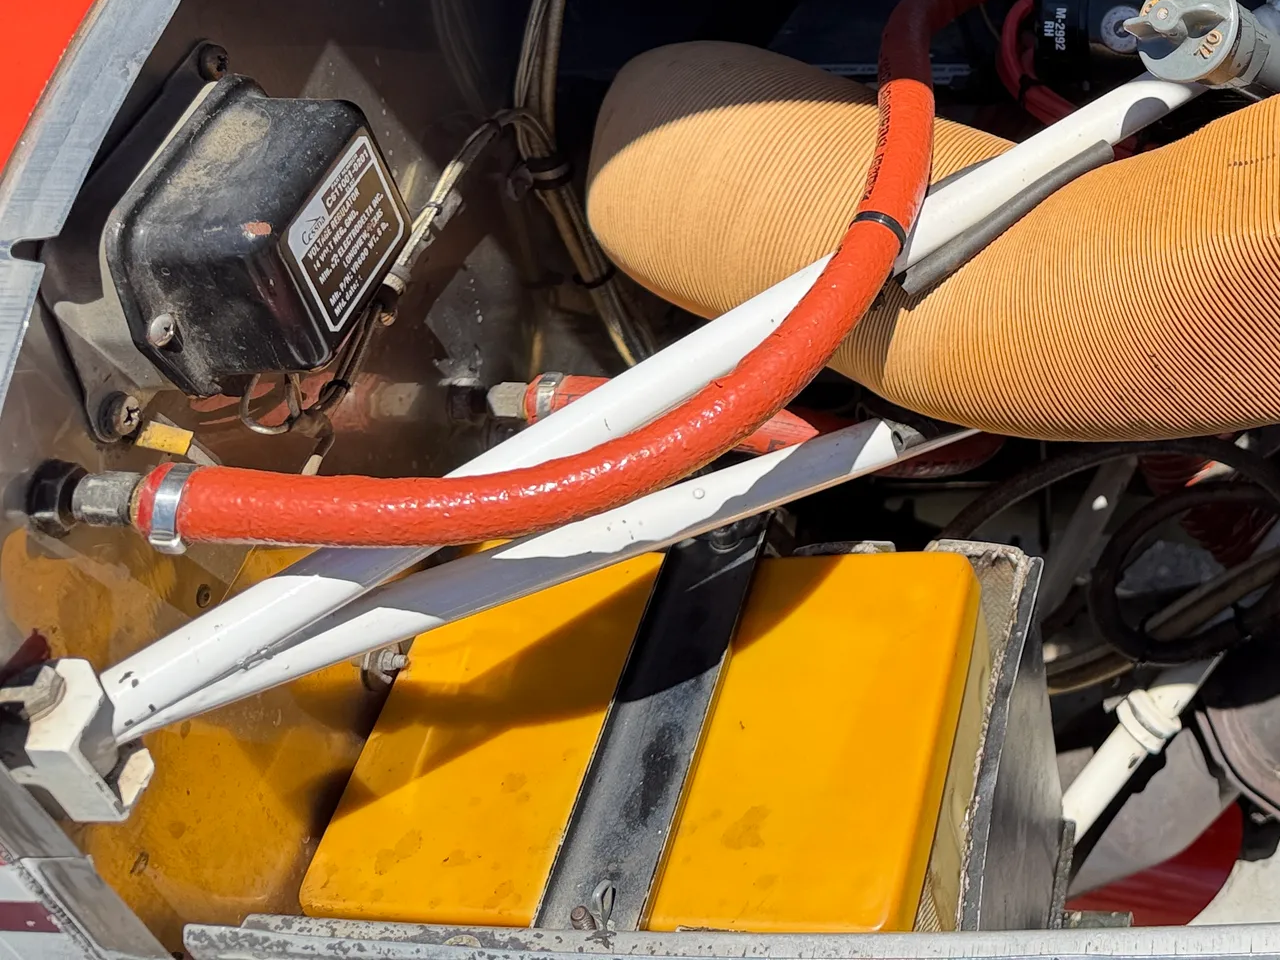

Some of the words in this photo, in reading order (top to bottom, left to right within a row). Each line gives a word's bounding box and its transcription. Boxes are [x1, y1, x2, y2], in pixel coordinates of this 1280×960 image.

[1043, 20, 1055, 37] RH
[1055, 7, 1067, 51] M-2992
[1193, 30, 1223, 60] OIL
[325, 148, 368, 209] C611001-0201
[301, 215, 326, 247] Cessna
[307, 224, 332, 261] VOLTAGE
[330, 186, 360, 231] REGULATOR
[332, 222, 346, 245] NEG.
[344, 205, 358, 228] GND.
[336, 203, 373, 258] ELECTRODELTA
[371, 189, 383, 209] INC.
[339, 269, 353, 292] P/N:
[350, 245, 369, 275] VR600
[342, 227, 369, 269] LONGVIEW,
